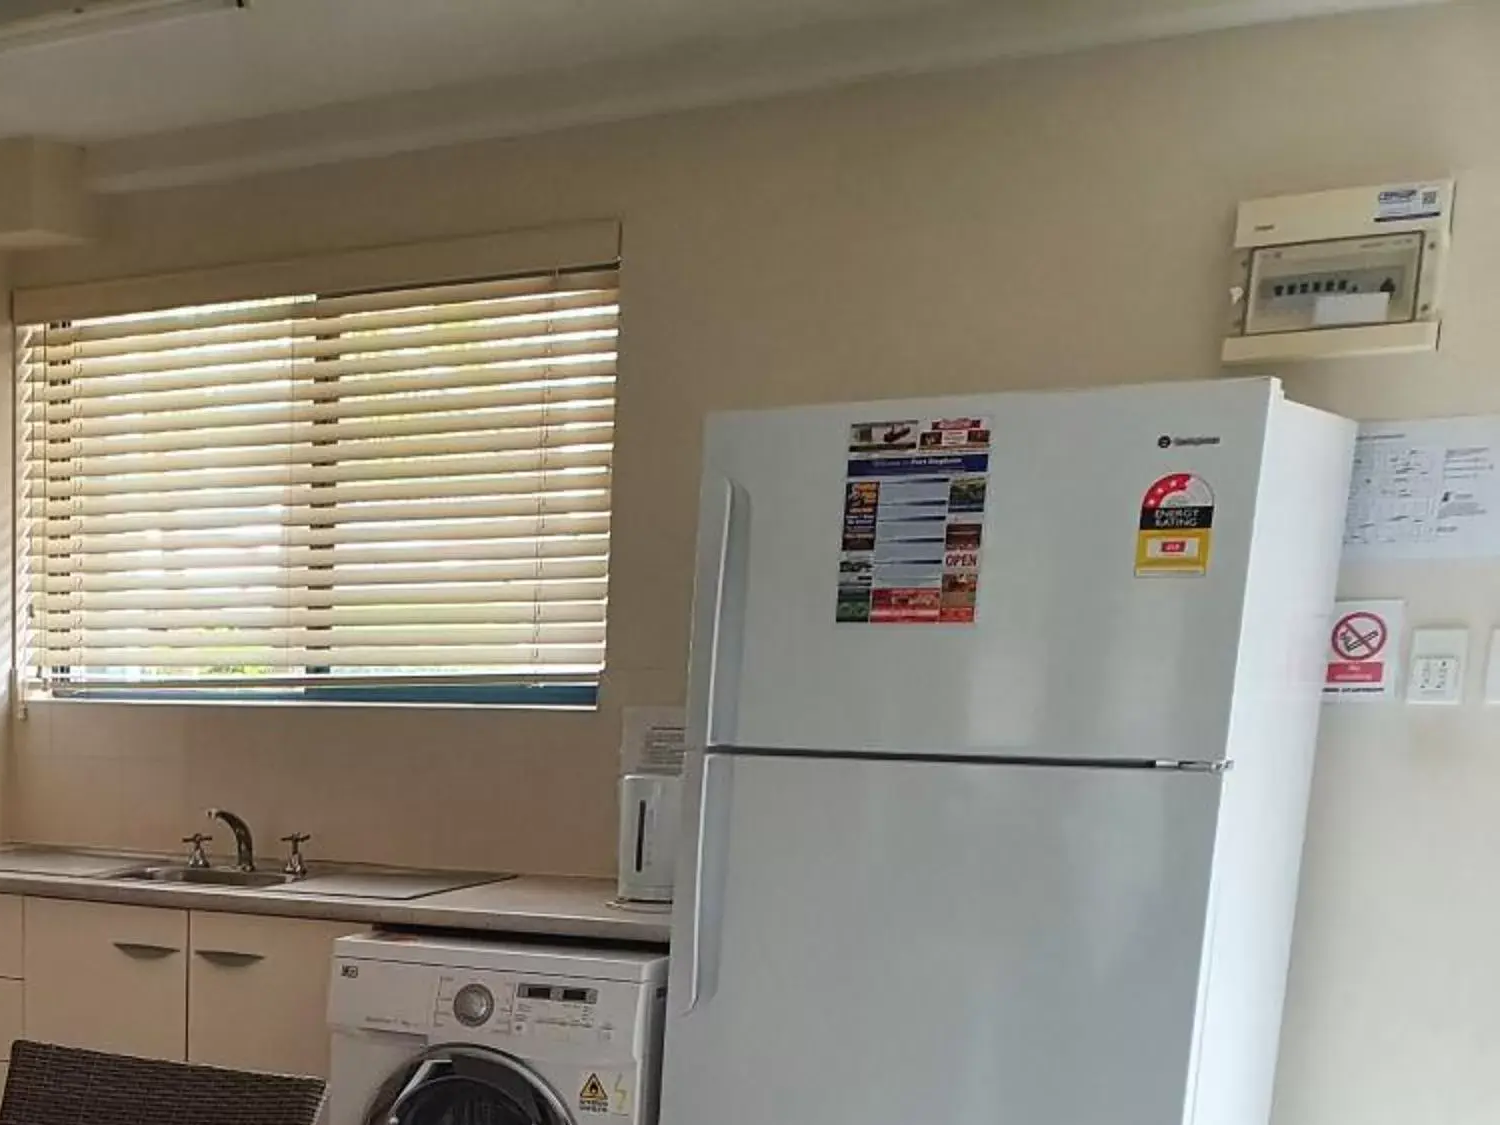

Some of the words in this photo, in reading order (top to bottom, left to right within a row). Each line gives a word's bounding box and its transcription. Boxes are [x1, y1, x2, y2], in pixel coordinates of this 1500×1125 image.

[1155, 509, 1199, 518] ENERGY
[1155, 518, 1198, 527] RATING
[946, 553, 977, 567] OPEN
